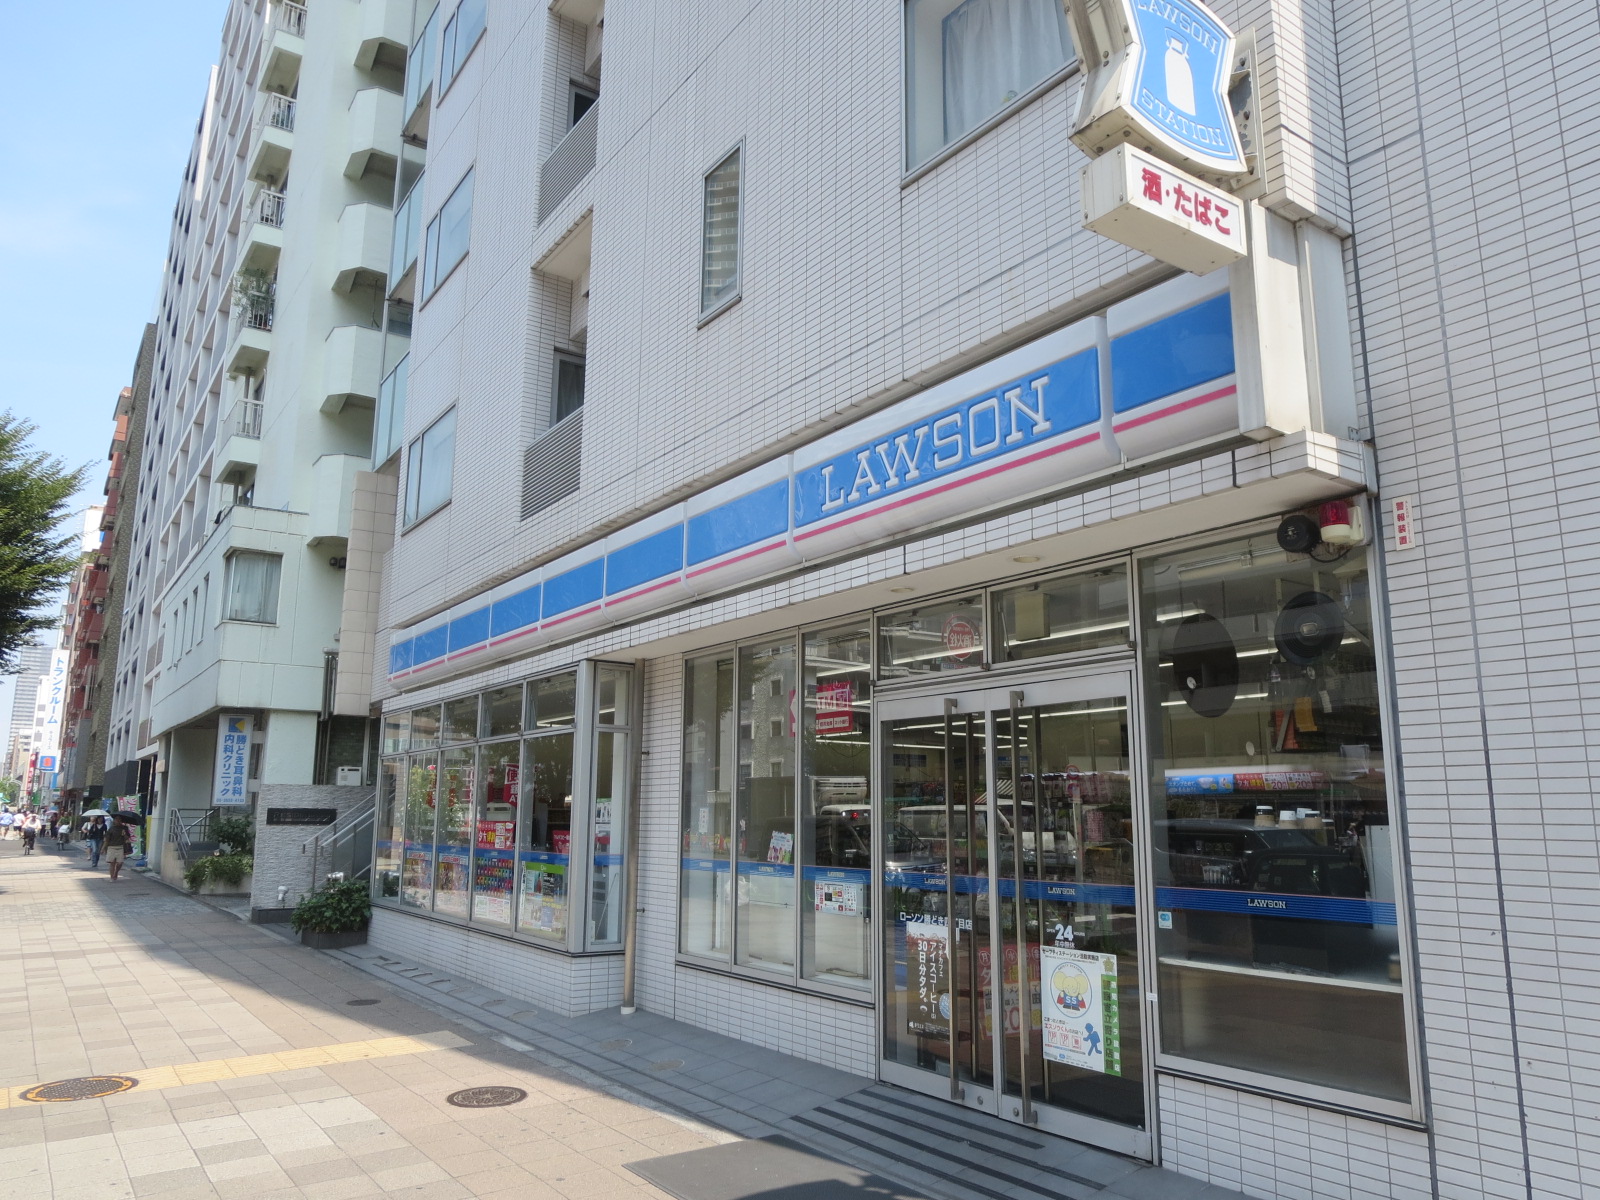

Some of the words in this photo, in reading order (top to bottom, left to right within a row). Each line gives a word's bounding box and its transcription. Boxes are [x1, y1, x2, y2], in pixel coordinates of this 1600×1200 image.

[1141, 87, 1225, 147] STATION
[1141, 167, 1231, 236] 酒・たばこ
[821, 375, 1052, 512] LAWSON
[47, 657, 65, 724] トランクルーム
[220, 733, 236, 797] 内科クリニック
[231, 734, 247, 797] 勝どき耳鼻科
[1047, 886, 1076, 896] LAWSON
[1247, 899, 1287, 909] LAWSON
[1055, 923, 1074, 942] 24
